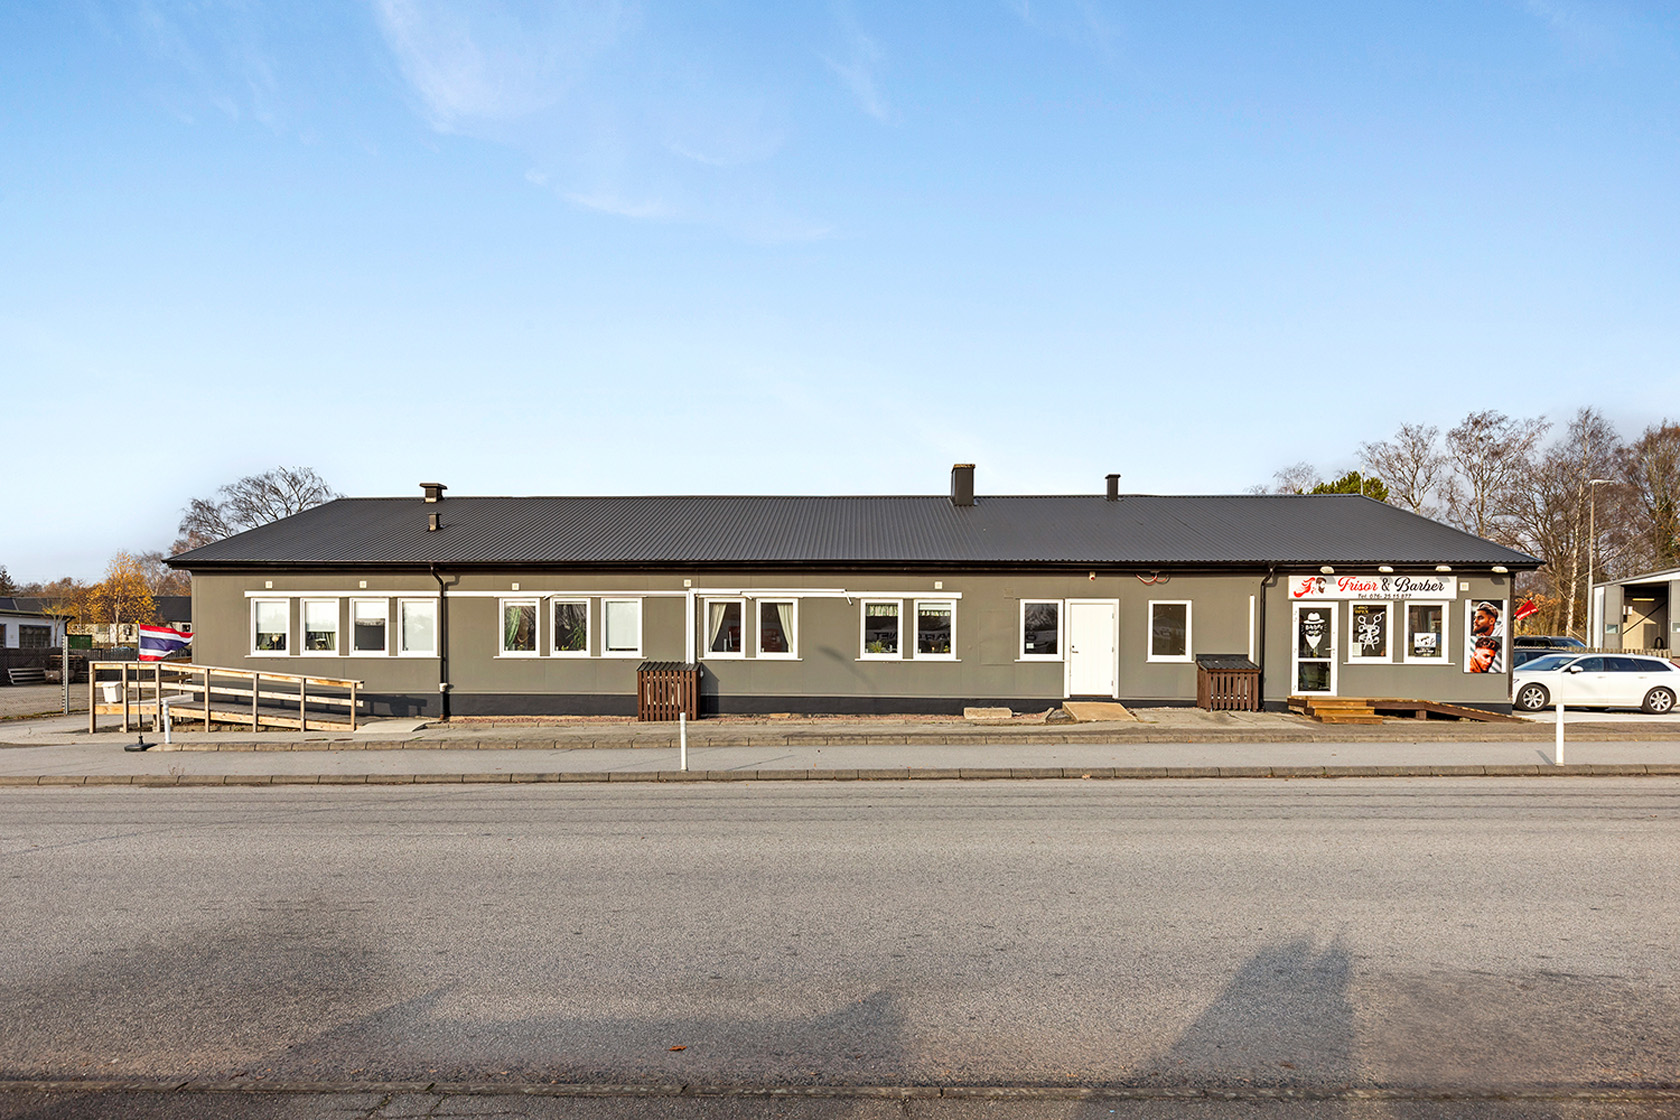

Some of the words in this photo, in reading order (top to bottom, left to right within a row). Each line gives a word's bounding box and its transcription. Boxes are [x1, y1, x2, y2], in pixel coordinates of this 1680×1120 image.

[1338, 576, 1379, 592] Frisör
[1381, 577, 1392, 592] &
[1394, 576, 1445, 593] Barber
